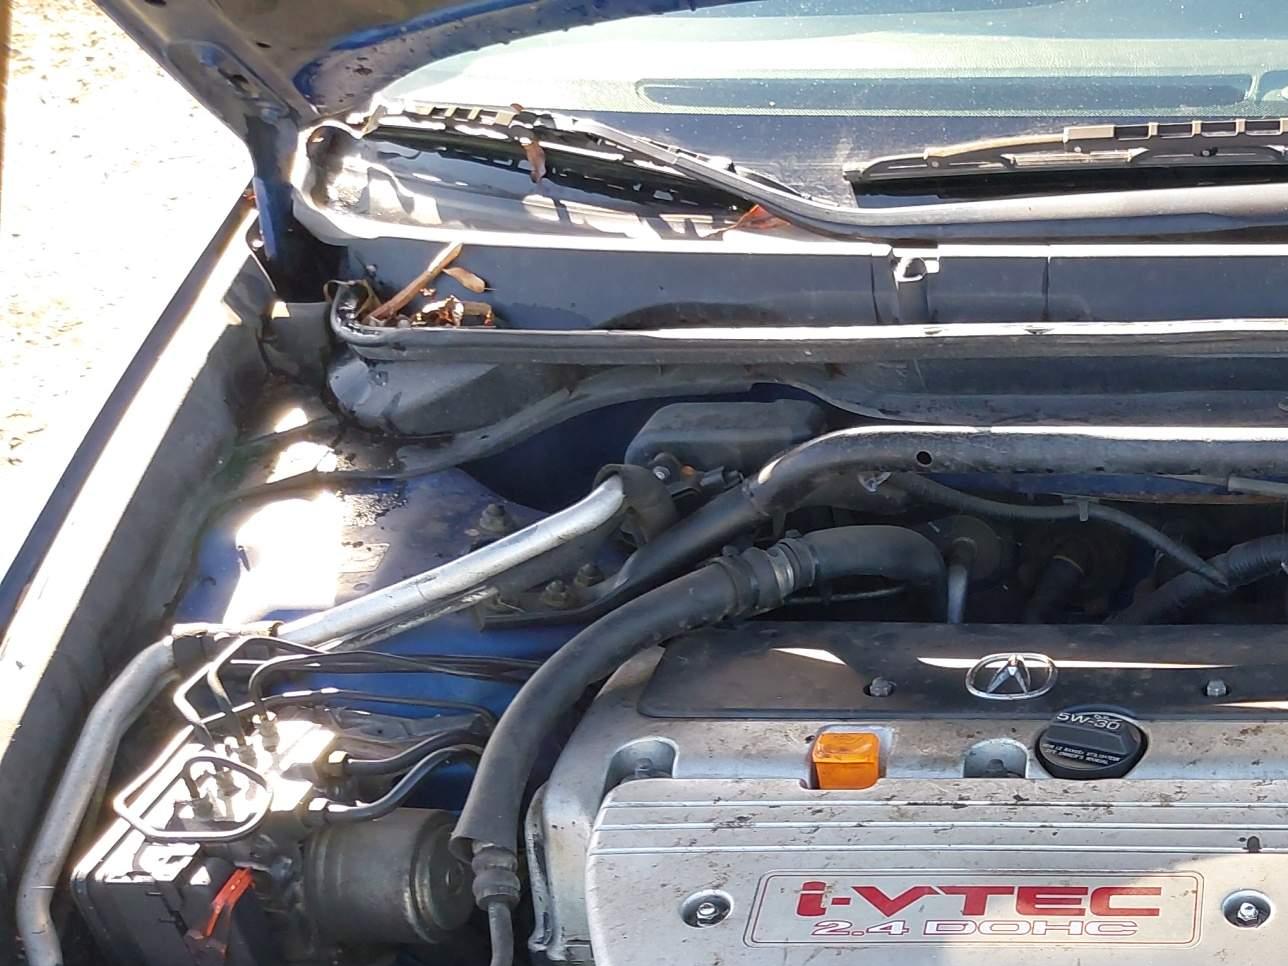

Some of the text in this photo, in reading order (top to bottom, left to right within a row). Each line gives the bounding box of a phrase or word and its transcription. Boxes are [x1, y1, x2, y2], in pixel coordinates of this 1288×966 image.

[1056, 712, 1121, 730] 5W-30
[796, 881, 1162, 919] i-VTEC
[811, 920, 1138, 937] 2.4 DOHC
